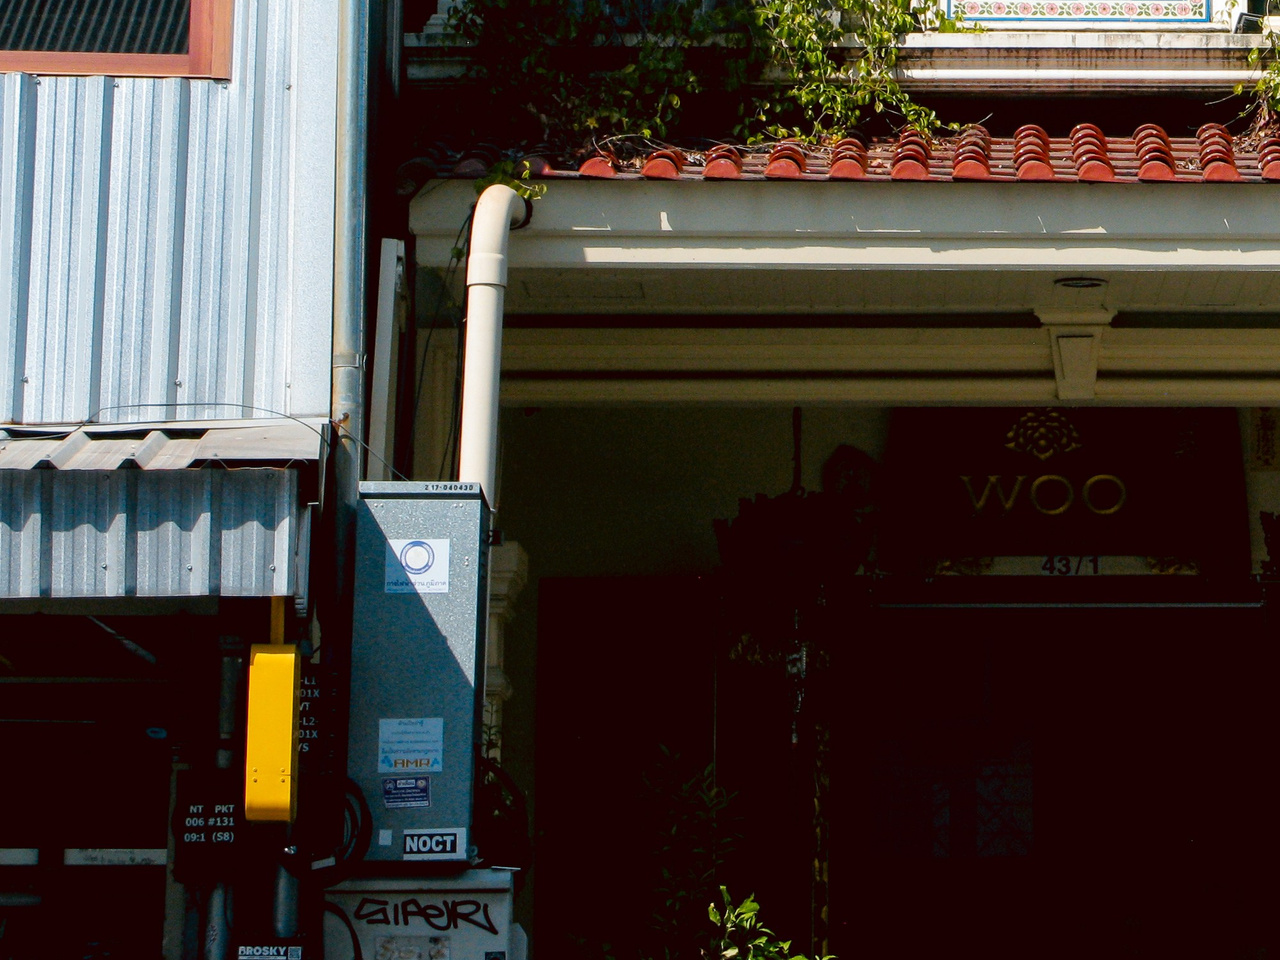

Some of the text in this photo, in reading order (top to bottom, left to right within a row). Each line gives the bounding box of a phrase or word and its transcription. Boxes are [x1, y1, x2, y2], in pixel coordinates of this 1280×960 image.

[960, 474, 1126, 515] WOO
[1041, 556, 1099, 575] 43/1
[189, 804, 235, 814] NT PKT
[185, 816, 235, 827] 006 #131
[184, 831, 235, 843] 09:1 (S8)
[405, 835, 455, 852] NOCT
[238, 946, 287, 955] BROSKY
